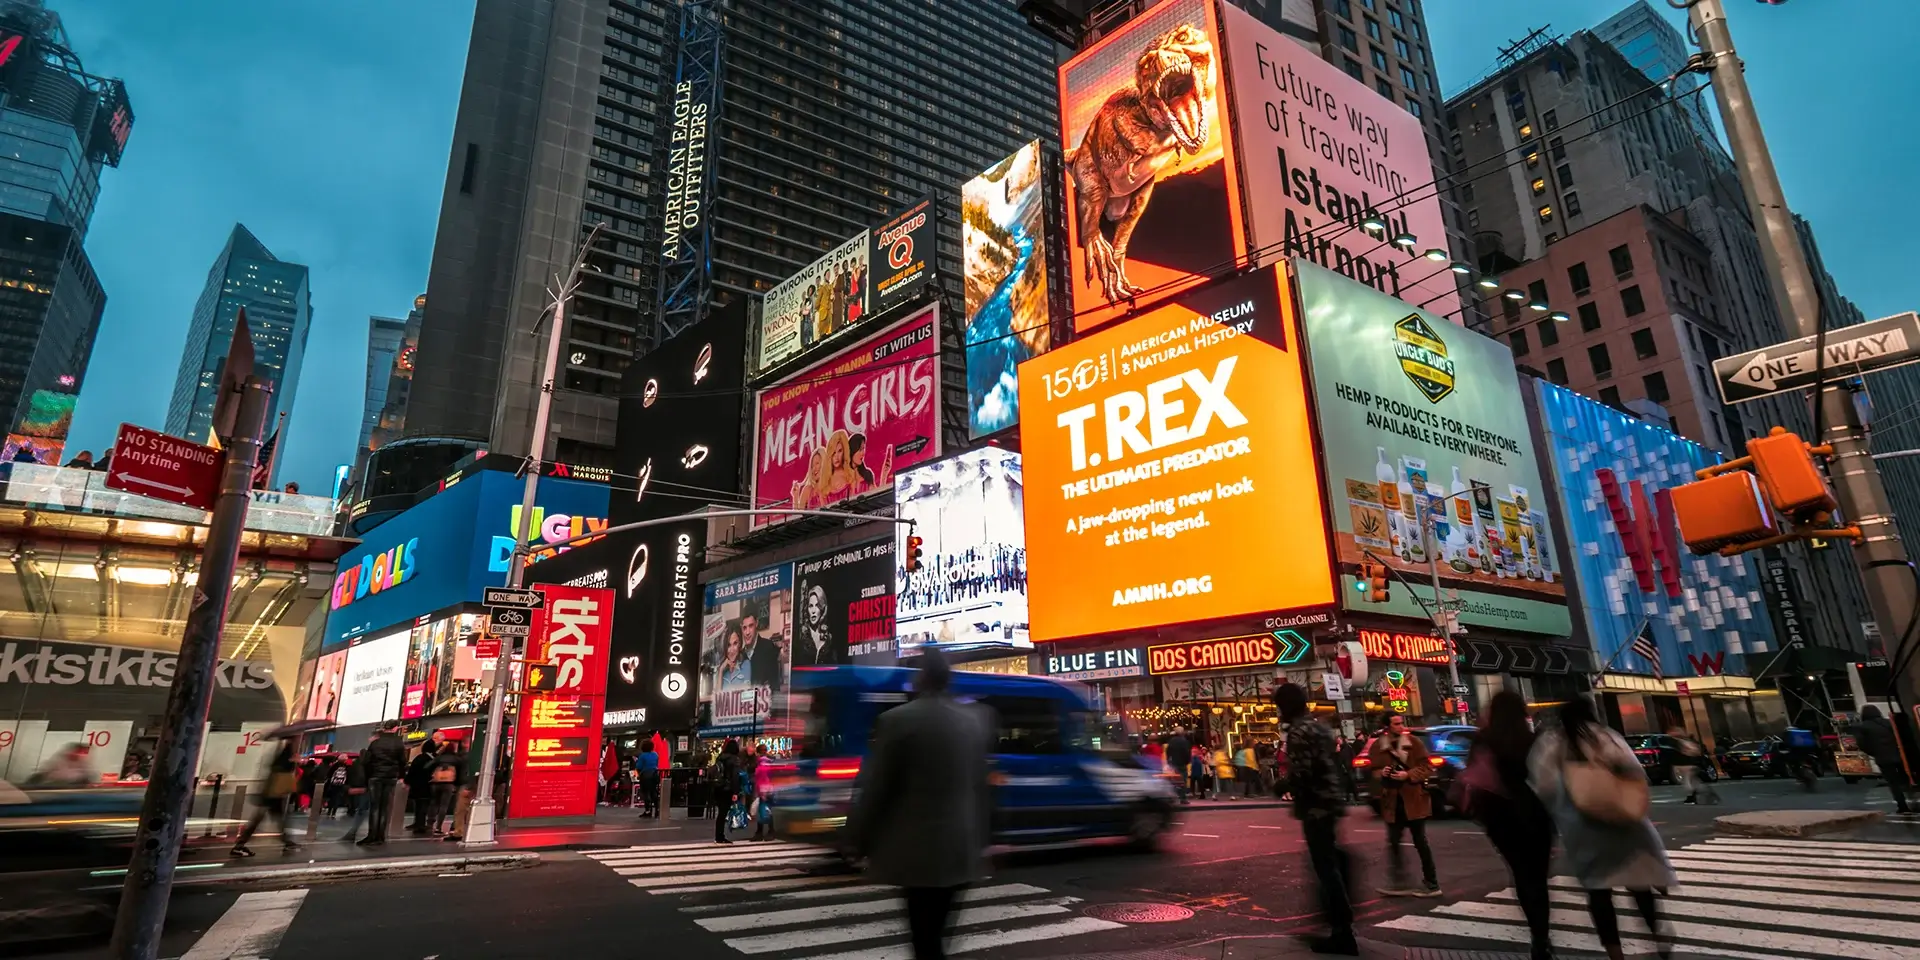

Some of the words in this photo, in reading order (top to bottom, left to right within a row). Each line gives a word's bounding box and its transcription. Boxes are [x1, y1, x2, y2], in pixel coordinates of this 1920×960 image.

[672, 80, 692, 142] EAGLE
[1255, 41, 1338, 121] Future
[1345, 104, 1388, 157] way
[682, 103, 707, 229] OUTFITTERS
[1265, 99, 1289, 138] of
[1298, 112, 1411, 207] traveling:
[663, 148, 687, 260] AMERICAN
[878, 212, 926, 250] Avenue
[888, 235, 913, 269] Q
[766, 290, 778, 305] SO
[780, 263, 815, 296] WRONG
[816, 252, 834, 276] IT'S
[835, 234, 867, 262] RIGHT
[880, 271, 923, 297] AvenueQ.com
[764, 312, 798, 336] WRONG
[1120, 325, 1187, 358] AMERICAN
[1190, 300, 1255, 334] MUSEUM
[1133, 342, 1192, 372] NATURAL
[1195, 319, 1255, 351] HISTORY
[1393, 341, 1426, 362] UNCLE
[1749, 356, 1803, 382] ONE
[1827, 334, 1891, 364] WAY
[764, 394, 781, 411] YOU
[782, 381, 811, 402] KNOW
[835, 352, 873, 378] WANNA
[874, 346, 888, 361] SIT
[889, 335, 916, 355] WITH
[763, 396, 835, 474] MEAN
[843, 357, 932, 433] GIRLS
[1057, 355, 1249, 472] T.REX
[1336, 382, 1372, 406] HEMP
[1376, 395, 1439, 428] PRODUCTS
[1441, 417, 1464, 437] FOR
[1467, 427, 1522, 456] EVERYONE,
[125, 432, 146, 447] NO
[149, 438, 215, 466] STANDING
[1367, 412, 1431, 444] AVAILABLE
[1434, 432, 1507, 466] EVERYWHERE.
[122, 446, 181, 471] Anytime
[573, 465, 614, 475] MARRIOTT
[1061, 480, 1089, 500] THE
[1090, 459, 1161, 492] ULTIMATE
[1163, 436, 1251, 474] PREDATOR
[573, 471, 610, 481] MARQUIS
[1066, 518, 1078, 533] A
[1078, 497, 1175, 535] jaw-dropping
[1178, 489, 1213, 509] new
[1216, 476, 1254, 499] look
[510, 504, 609, 546] UGLY
[1105, 531, 1121, 547] at
[1123, 526, 1149, 544] the
[1151, 511, 1211, 539] legend.
[823, 558, 833, 571] BE
[833, 549, 864, 567] CRIMINAL
[863, 546, 872, 559] TO
[872, 544, 887, 558] MISS
[493, 593, 511, 602] ONE
[518, 594, 536, 603] WAY
[715, 586, 735, 599] SARA
[737, 574, 779, 593] BAREILLES
[861, 584, 886, 598] STARRING
[1112, 575, 1213, 607] AMNH.ORG
[848, 594, 897, 623] CHRISTI
[492, 625, 508, 634] BIKE
[510, 625, 528, 634] LANE
[548, 596, 600, 689] tkts
[1360, 630, 1392, 658] DOS
[848, 644, 864, 657] APRIL
[1049, 652, 1096, 674] BLUE
[1105, 648, 1138, 668] FIN
[1153, 645, 1186, 671] DOS
[1190, 638, 1275, 667] CAMINOS
[1688, 651, 1725, 678] W
[1388, 688, 1408, 701] BAR
[0, 731, 14, 748] 9
[86, 731, 111, 748] 10
